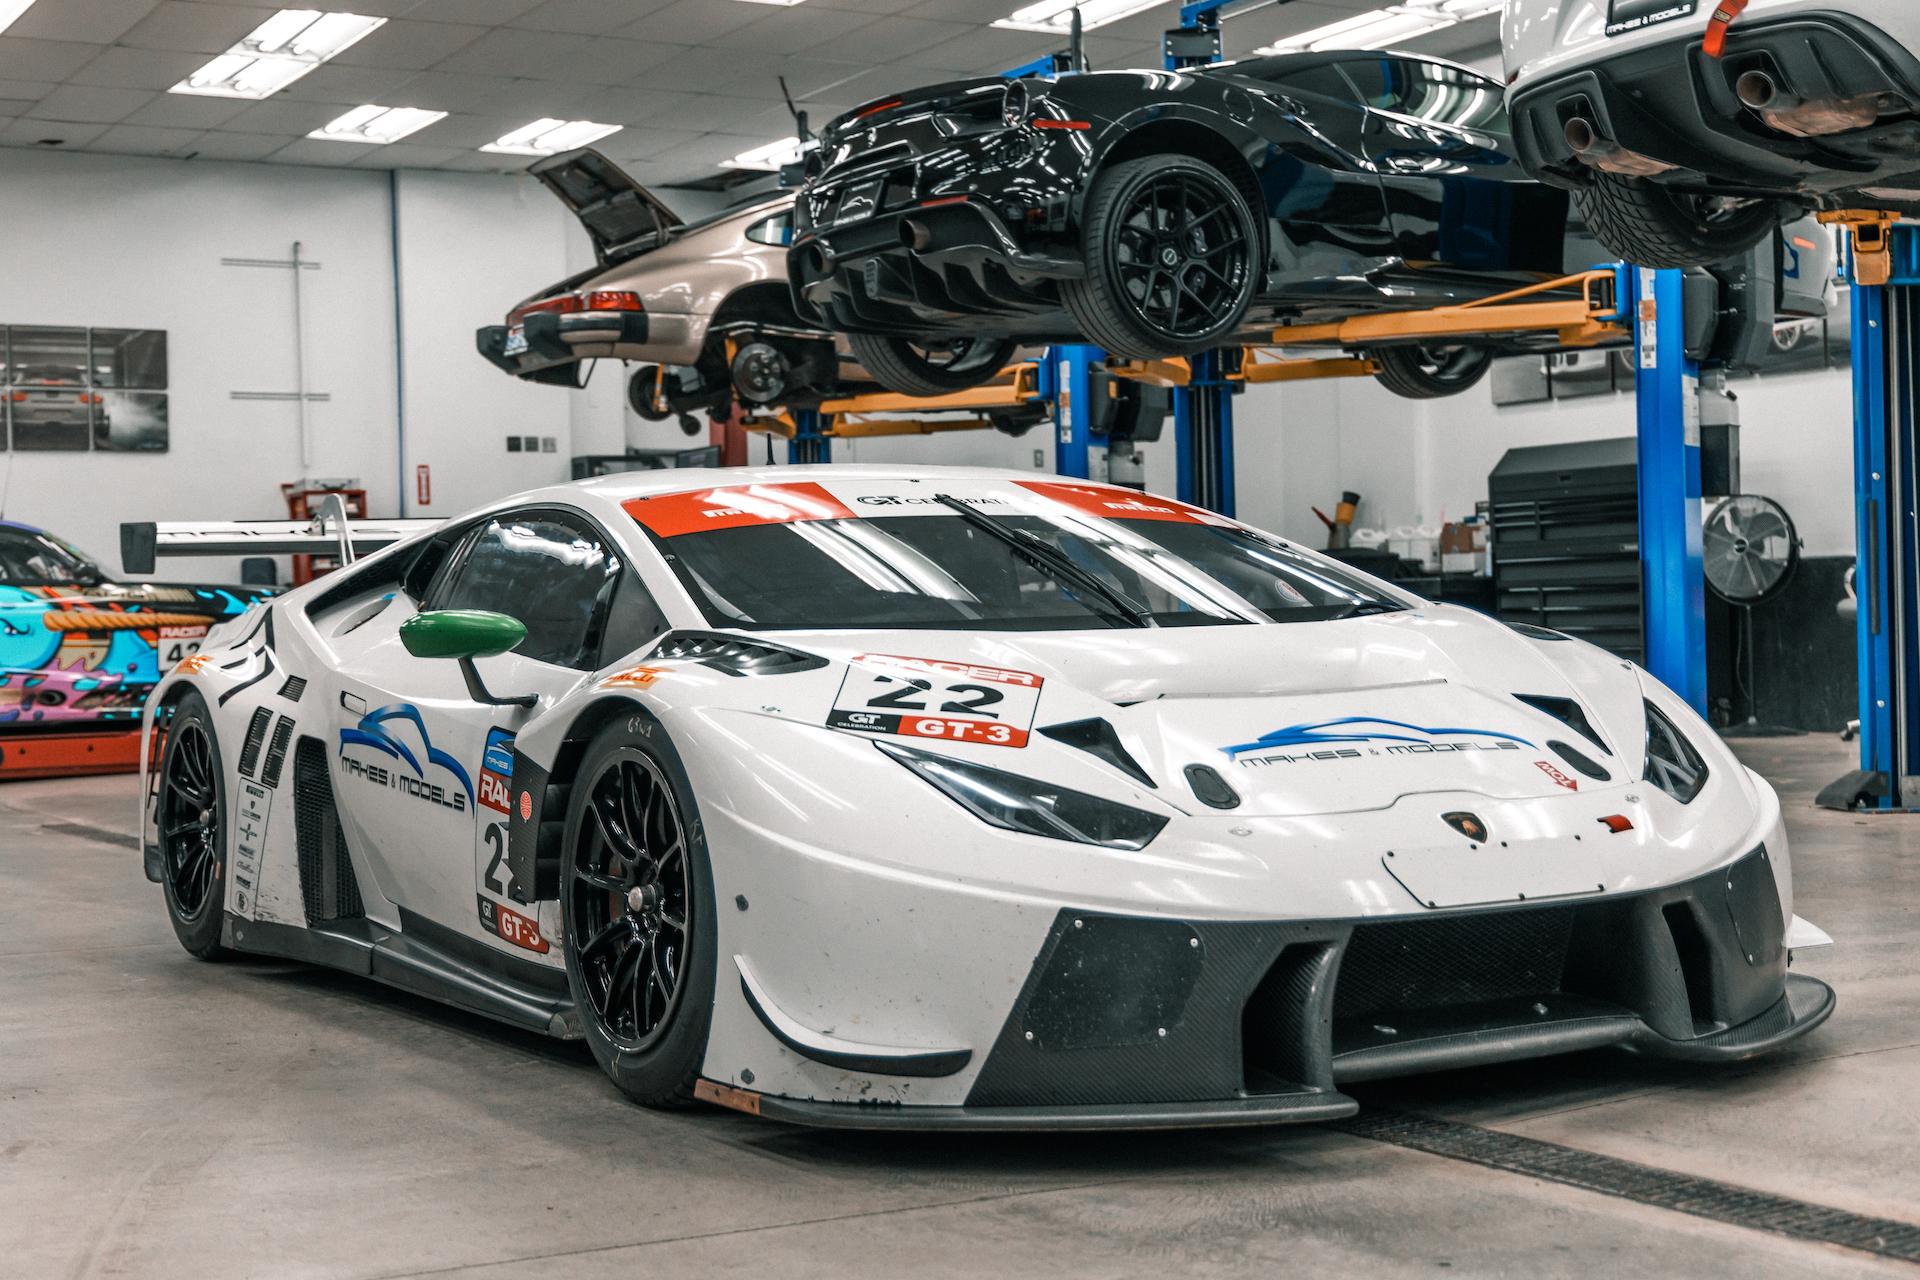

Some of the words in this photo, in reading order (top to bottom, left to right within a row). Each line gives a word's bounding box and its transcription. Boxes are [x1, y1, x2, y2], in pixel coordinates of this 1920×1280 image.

[1642, 16, 1649, 25] &
[857, 495, 902, 505] GT
[866, 675, 1004, 719] 22
[837, 721, 887, 731] CELEBRATION
[848, 713, 881, 724] GT
[916, 719, 1011, 742] GT-3
[1240, 748, 1362, 768] MAKES
[1386, 741, 1520, 754] MODELS
[342, 756, 388, 787] MAKES
[391, 773, 396, 788] &
[400, 774, 466, 812] MODELS
[1536, 762, 1570, 786] TOW
[502, 912, 540, 946] GT-3
